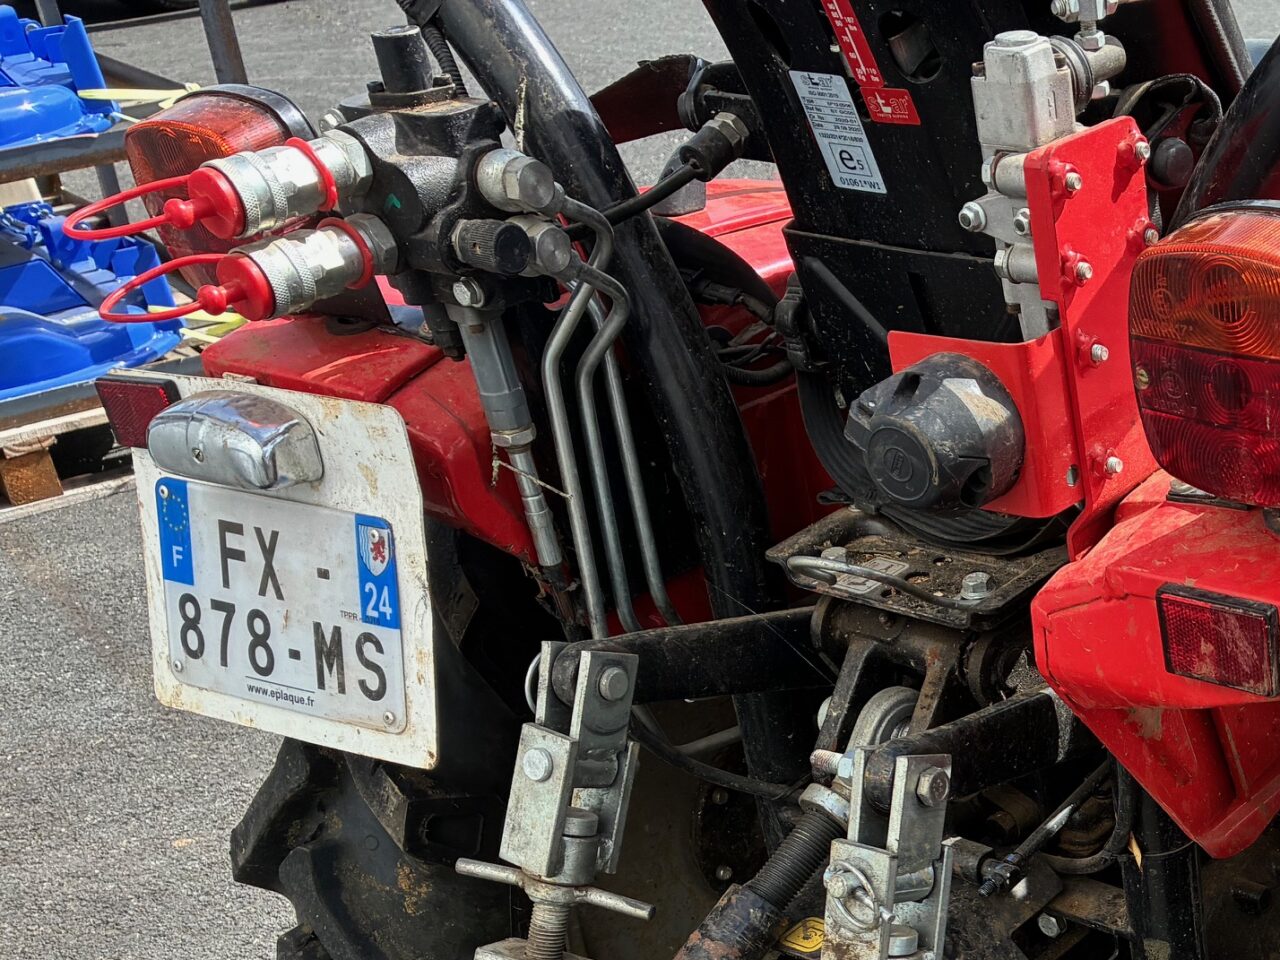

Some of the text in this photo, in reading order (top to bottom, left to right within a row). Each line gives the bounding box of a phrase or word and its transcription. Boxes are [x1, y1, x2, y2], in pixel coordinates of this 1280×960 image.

[867, 92, 909, 115] star
[172, 543, 184, 568] F
[218, 519, 284, 601] FX
[364, 582, 392, 620] 24
[178, 593, 388, 702] 878-MS
[246, 683, 315, 707] www.eplaque.fr
